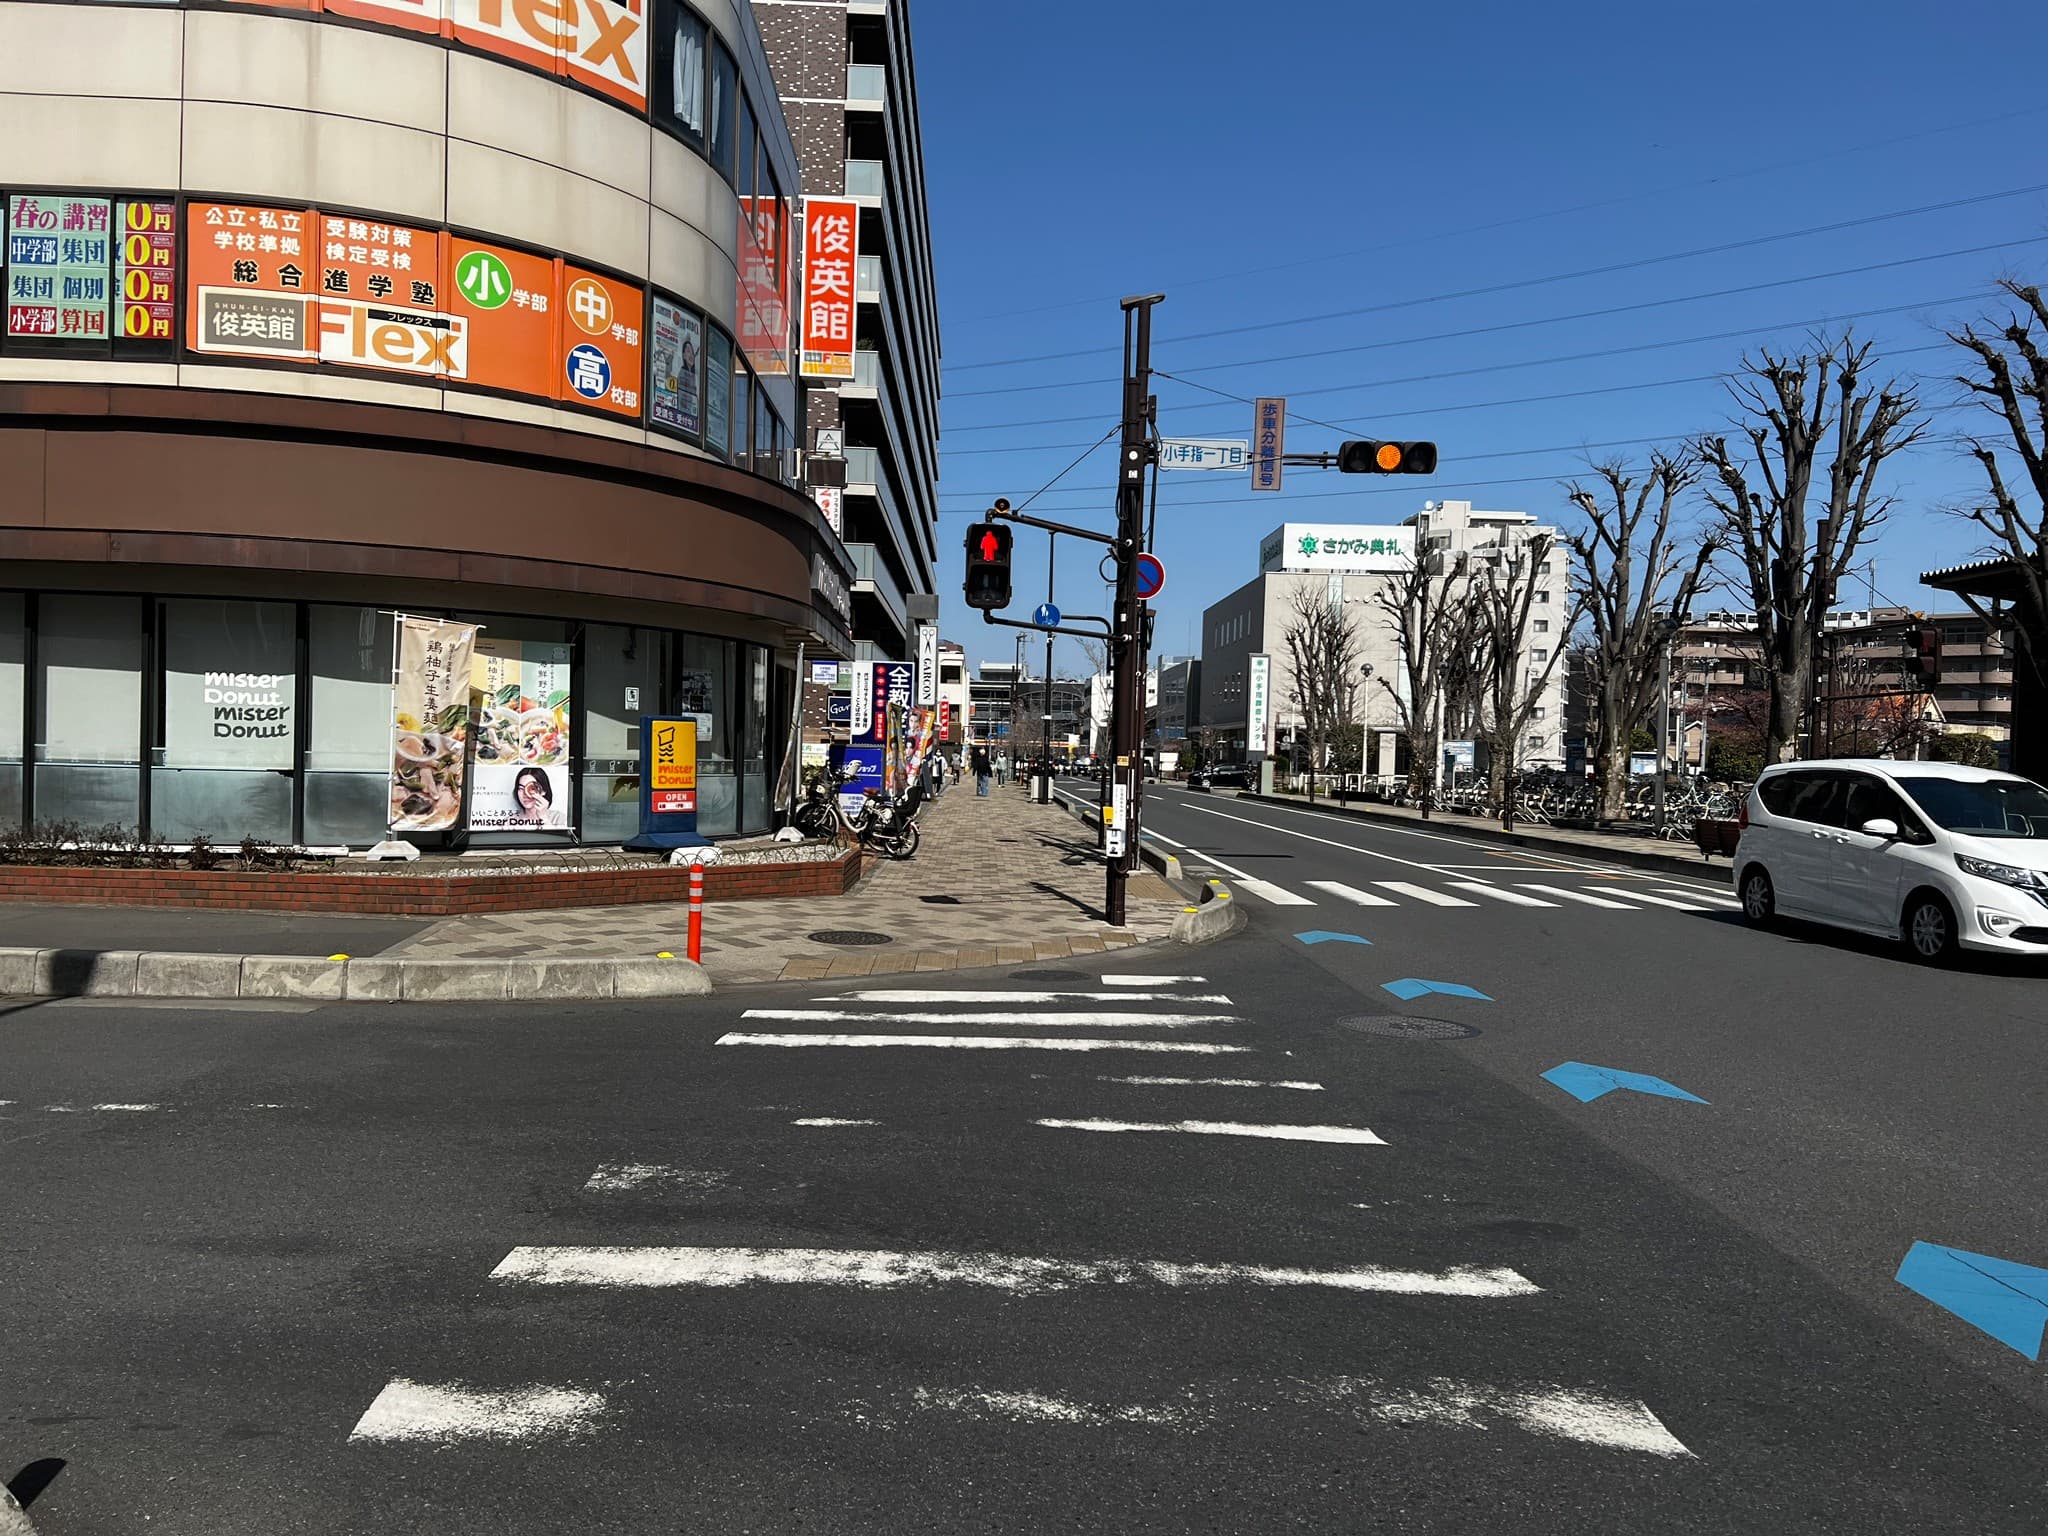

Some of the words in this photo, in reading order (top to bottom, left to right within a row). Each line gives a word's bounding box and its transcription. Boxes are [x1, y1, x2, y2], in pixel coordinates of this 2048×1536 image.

[12, 197, 58, 230] 春の
[62, 202, 109, 233] 講習
[205, 206, 301, 233] 公立・私立
[214, 231, 301, 256] 学校準拠
[325, 219, 413, 248] 受験対策
[12, 238, 56, 257] 中学部
[62, 239, 105, 264] 集団
[325, 243, 412, 271] 検定受検
[13, 275, 53, 299] 集団
[62, 276, 104, 300] 個別
[809, 214, 850, 341] 俊英館
[10, 311, 56, 333] 小学部
[60, 308, 104, 335] 算国
[212, 312, 296, 342] 俊英館
[387, 312, 433, 327] フレックス
[319, 302, 461, 372] Flex
[1163, 447, 1242, 464] 小手指一丁目
[1258, 403, 1278, 486] 歩車分離信号
[1323, 537, 1401, 556] さがみ典礼
[204, 688, 284, 706] Donut
[213, 722, 290, 738] Donut
[658, 776, 693, 785] Donut
[665, 793, 687, 801] OPEN
[509, 817, 545, 826] Donut
